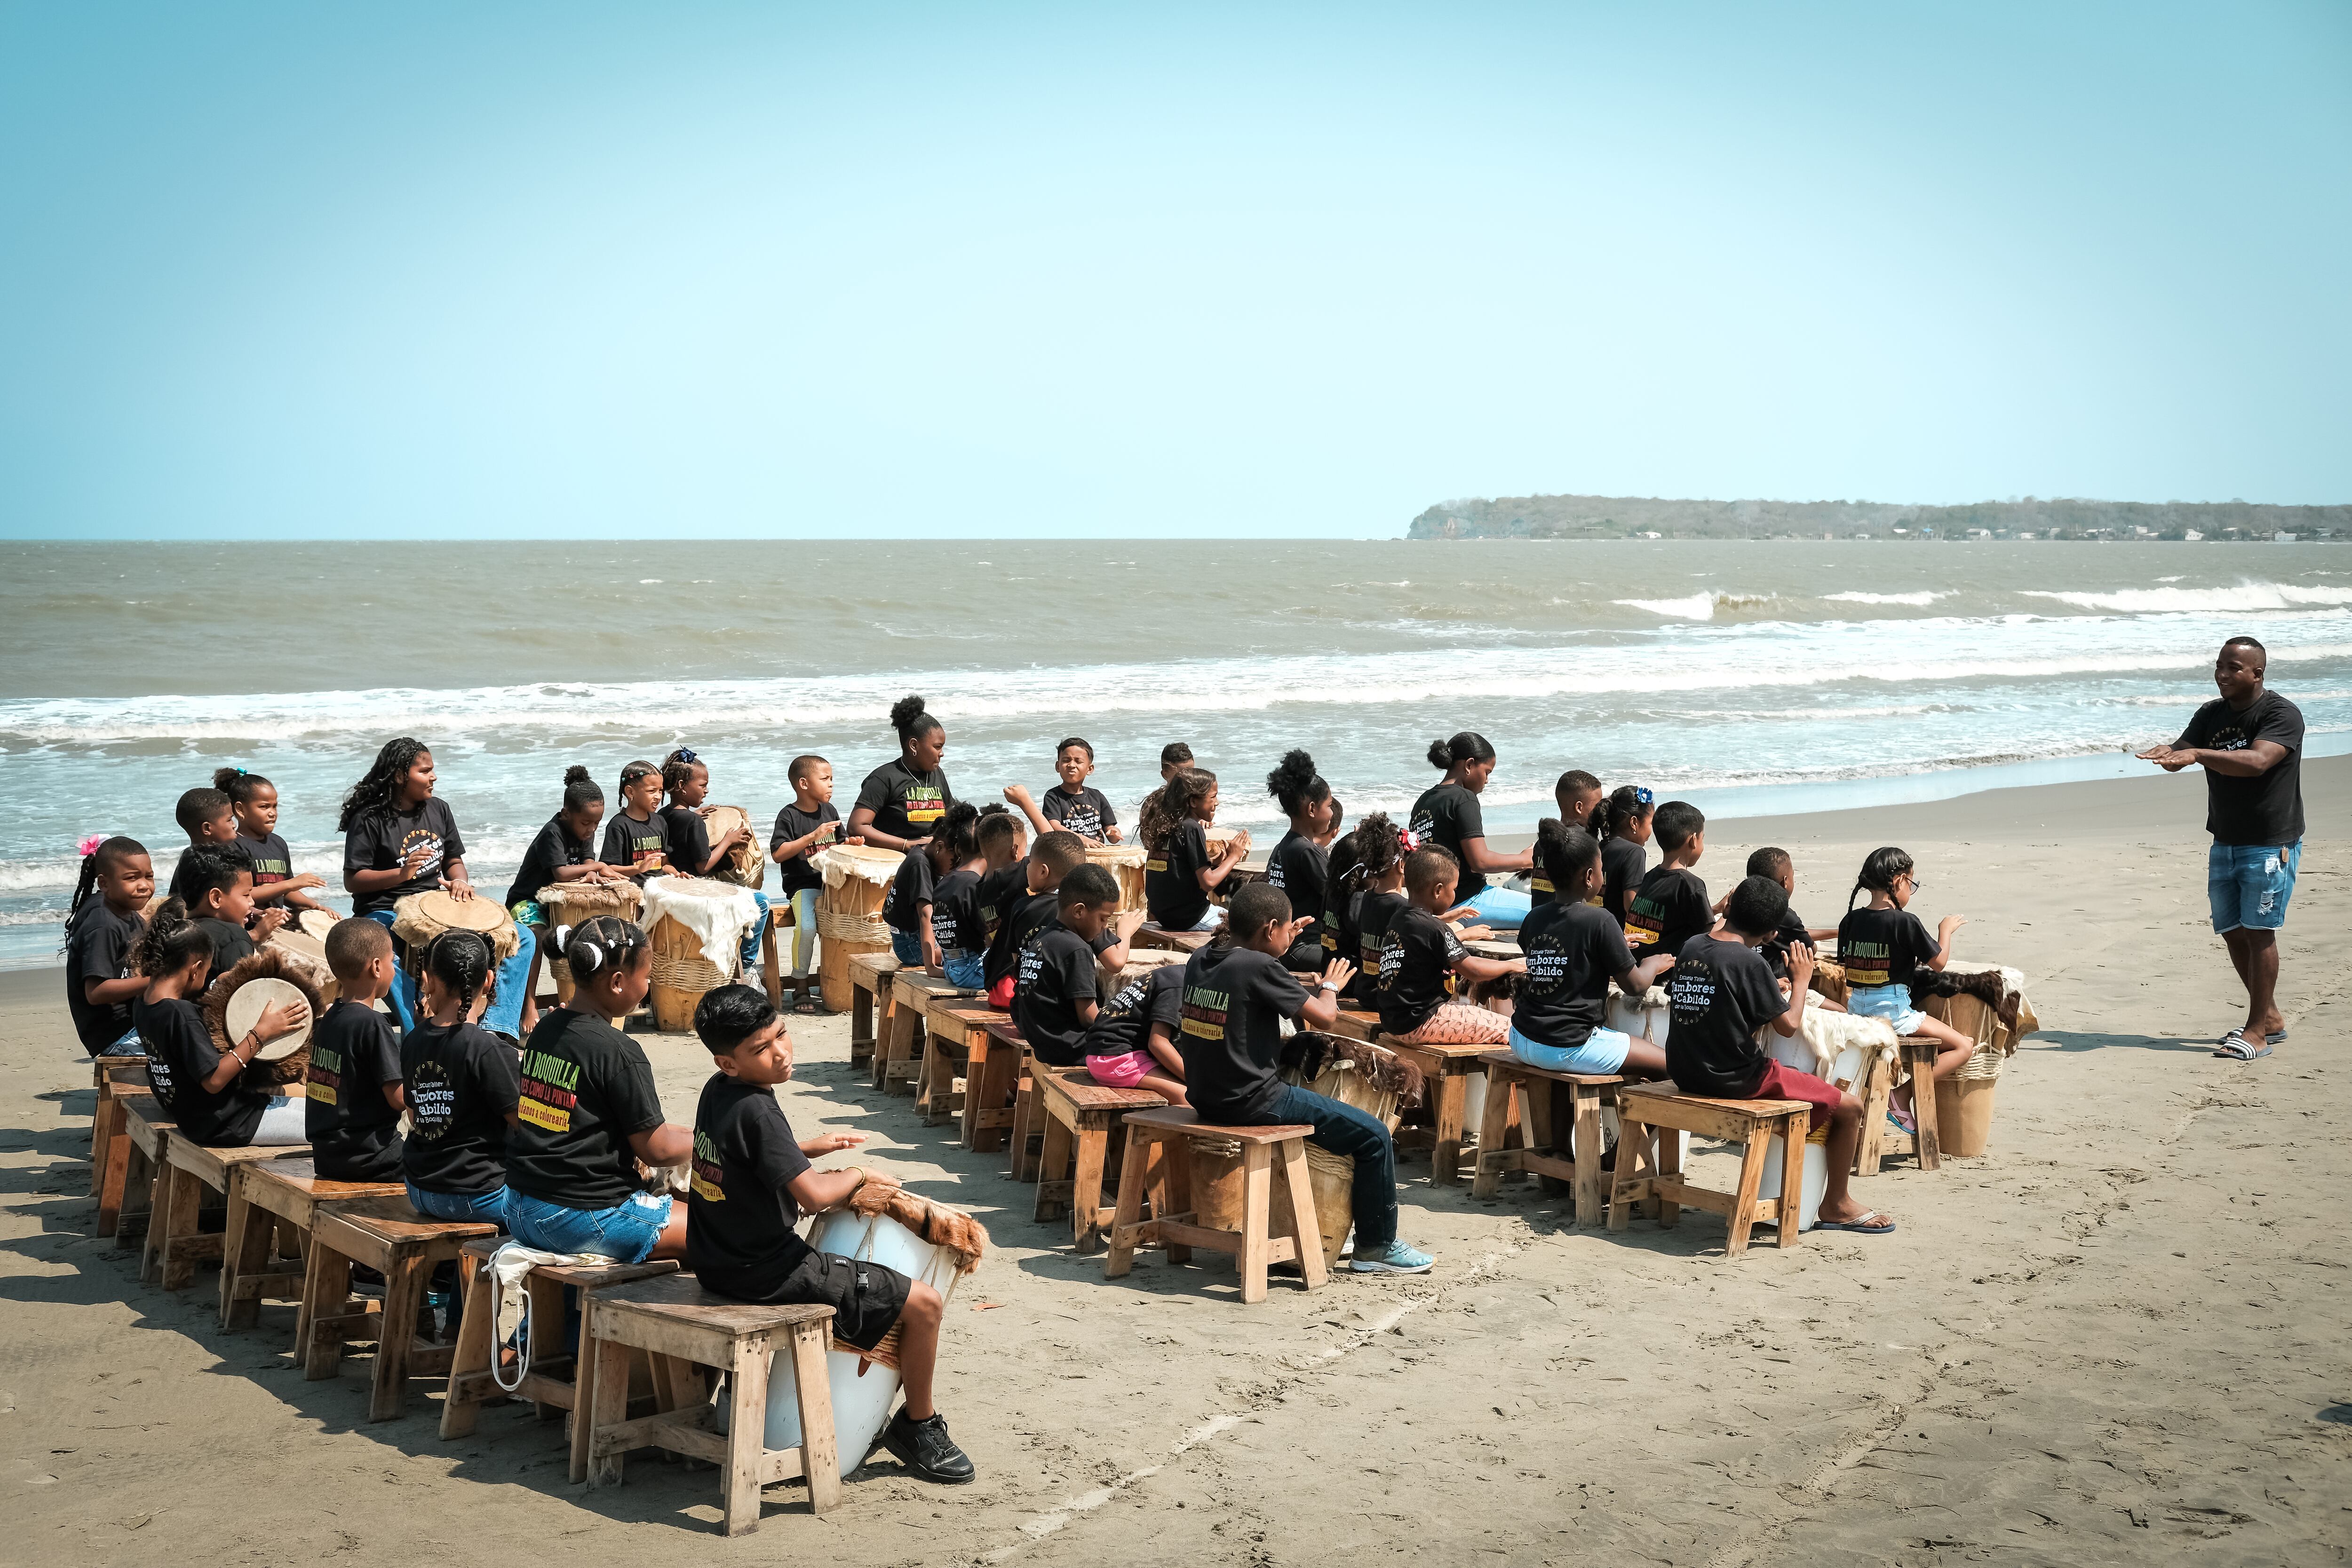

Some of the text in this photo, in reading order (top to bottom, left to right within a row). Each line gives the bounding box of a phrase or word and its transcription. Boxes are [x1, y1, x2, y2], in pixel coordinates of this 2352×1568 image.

[1416, 820, 1434, 834] bores
[1418, 830, 1432, 841] bildo
[633, 838, 642, 851] LA
[255, 859, 266, 872] LA
[1630, 896, 1665, 921] BOQUILLA
[932, 920, 956, 930] ambores
[1854, 941, 1890, 959] BOQUILLA
[1865, 972, 1887, 980] colorearla
[1671, 981, 1715, 994] Tambores
[1184, 985, 1229, 1011] LA BOQUILLA
[1677, 993, 1710, 1005] Cabildo
[1207, 1011, 1227, 1024] PINTAN
[1200, 1026, 1220, 1037] colorearla
[523, 1049, 533, 1075] LA
[532, 1052, 580, 1091] BOQUILLA
[529, 1081, 545, 1098] COMO
[544, 1086, 550, 1101] LA
[551, 1089, 577, 1109] PINTAN
[421, 1103, 451, 1115] abildo
[535, 1109, 538, 1118] a
[540, 1111, 567, 1127] colorearla
